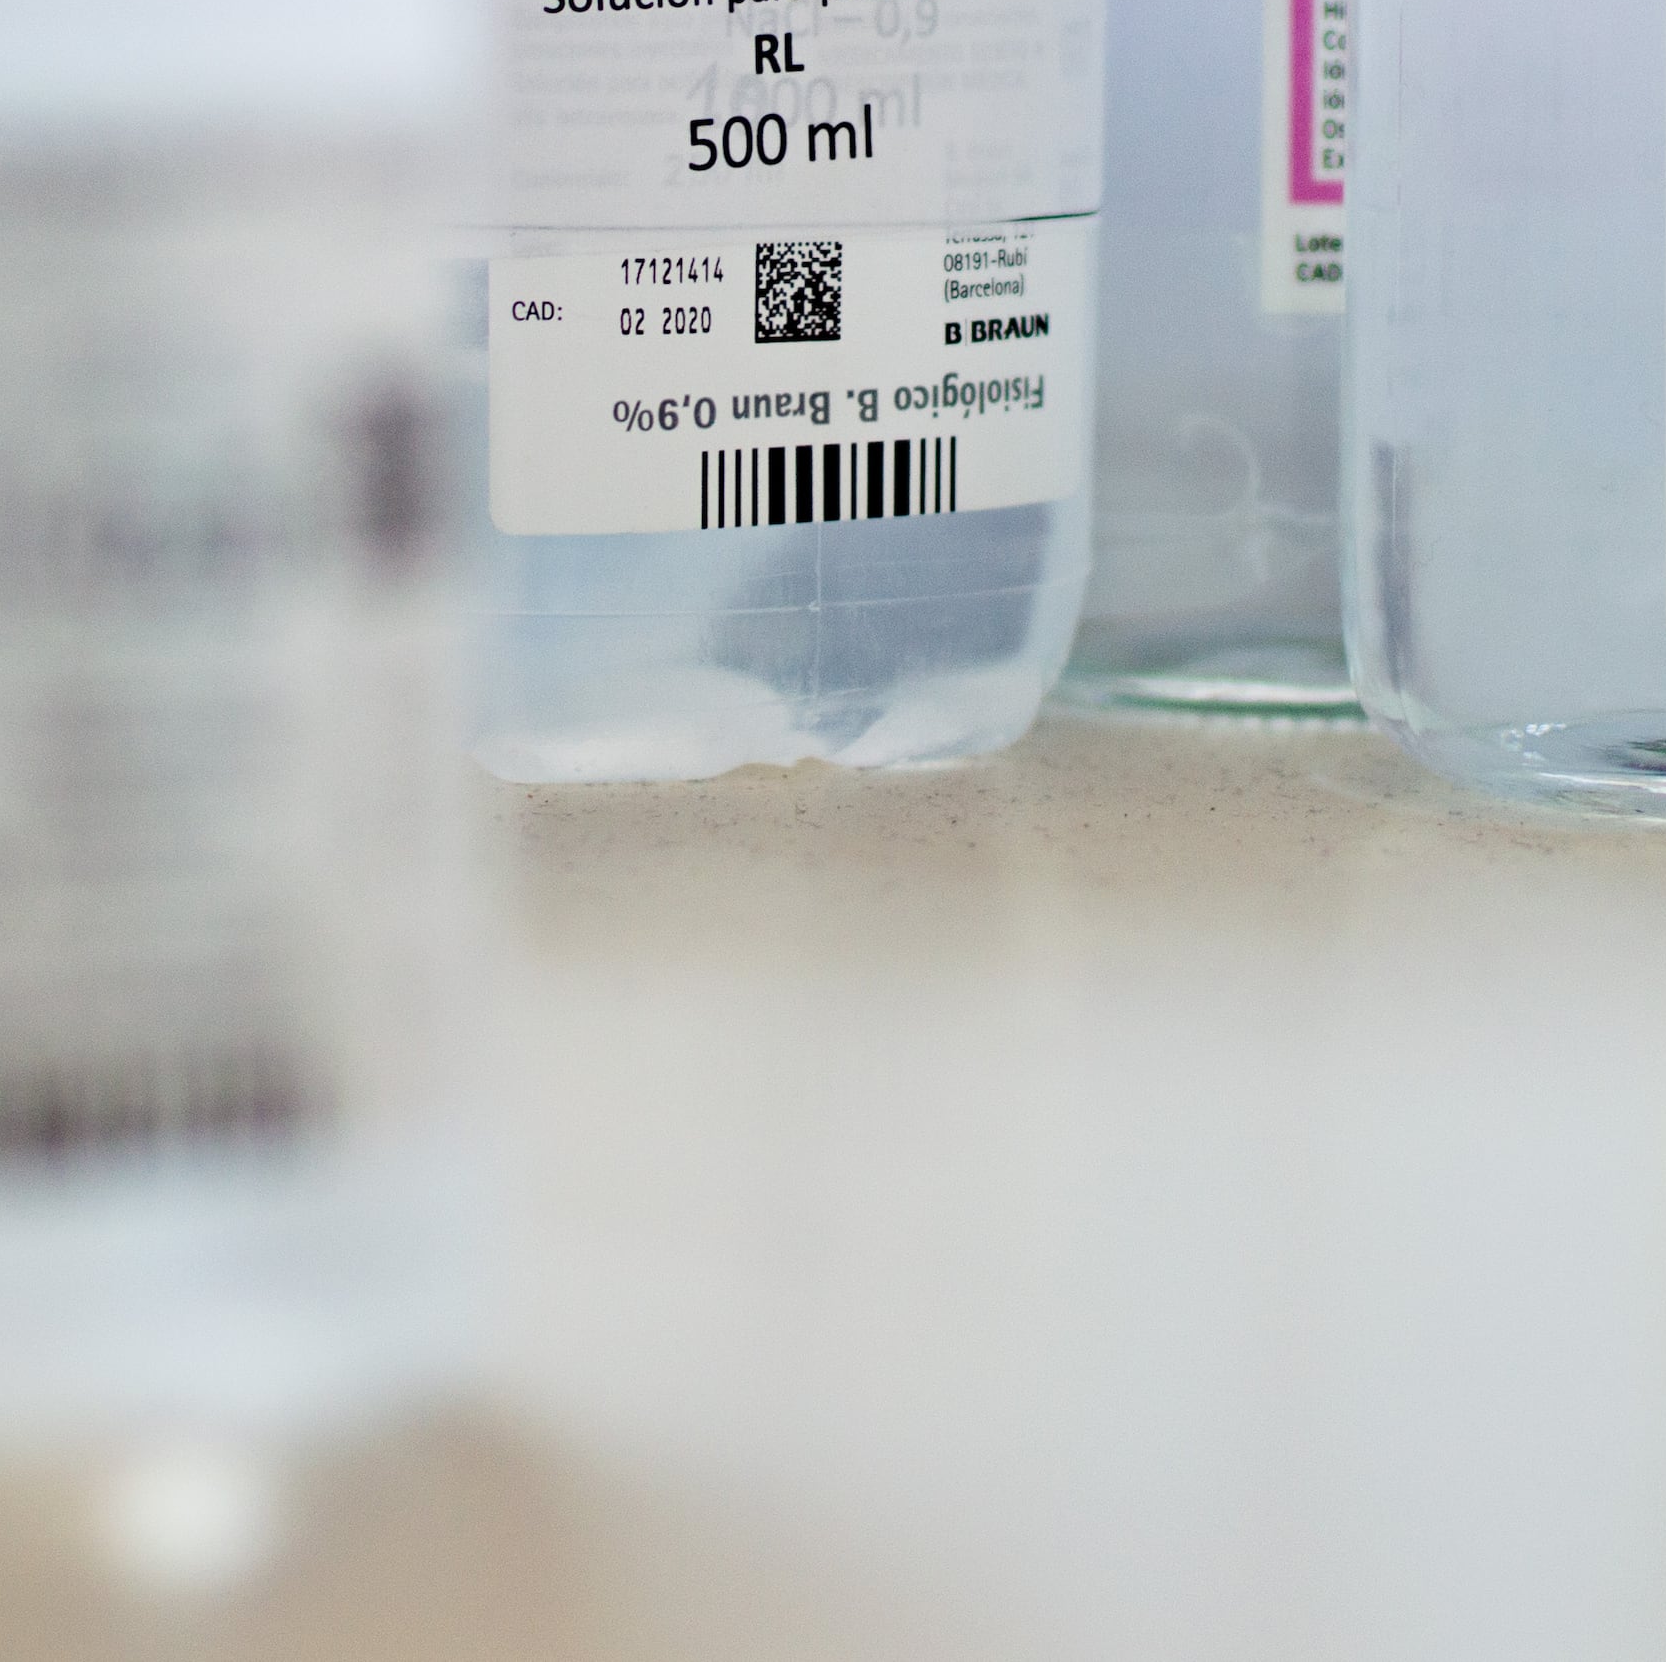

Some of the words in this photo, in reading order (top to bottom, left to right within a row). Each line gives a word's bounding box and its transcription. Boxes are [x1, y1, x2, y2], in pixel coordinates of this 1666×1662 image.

[754, 32, 805, 75] RL
[687, 113, 789, 172] 500
[807, 103, 875, 162] ml
[620, 256, 725, 286] 17121414
[944, 273, 1024, 303] (Barcelona)
[511, 300, 564, 323] CAD:
[619, 307, 645, 336] 02
[662, 305, 713, 335] 2020
[971, 312, 1050, 344] BRAUN
[612, 395, 717, 432] 0,9%
[732, 390, 831, 425] Braun
[845, 388, 879, 421] B.
[894, 373, 1045, 420] Fisiológico
